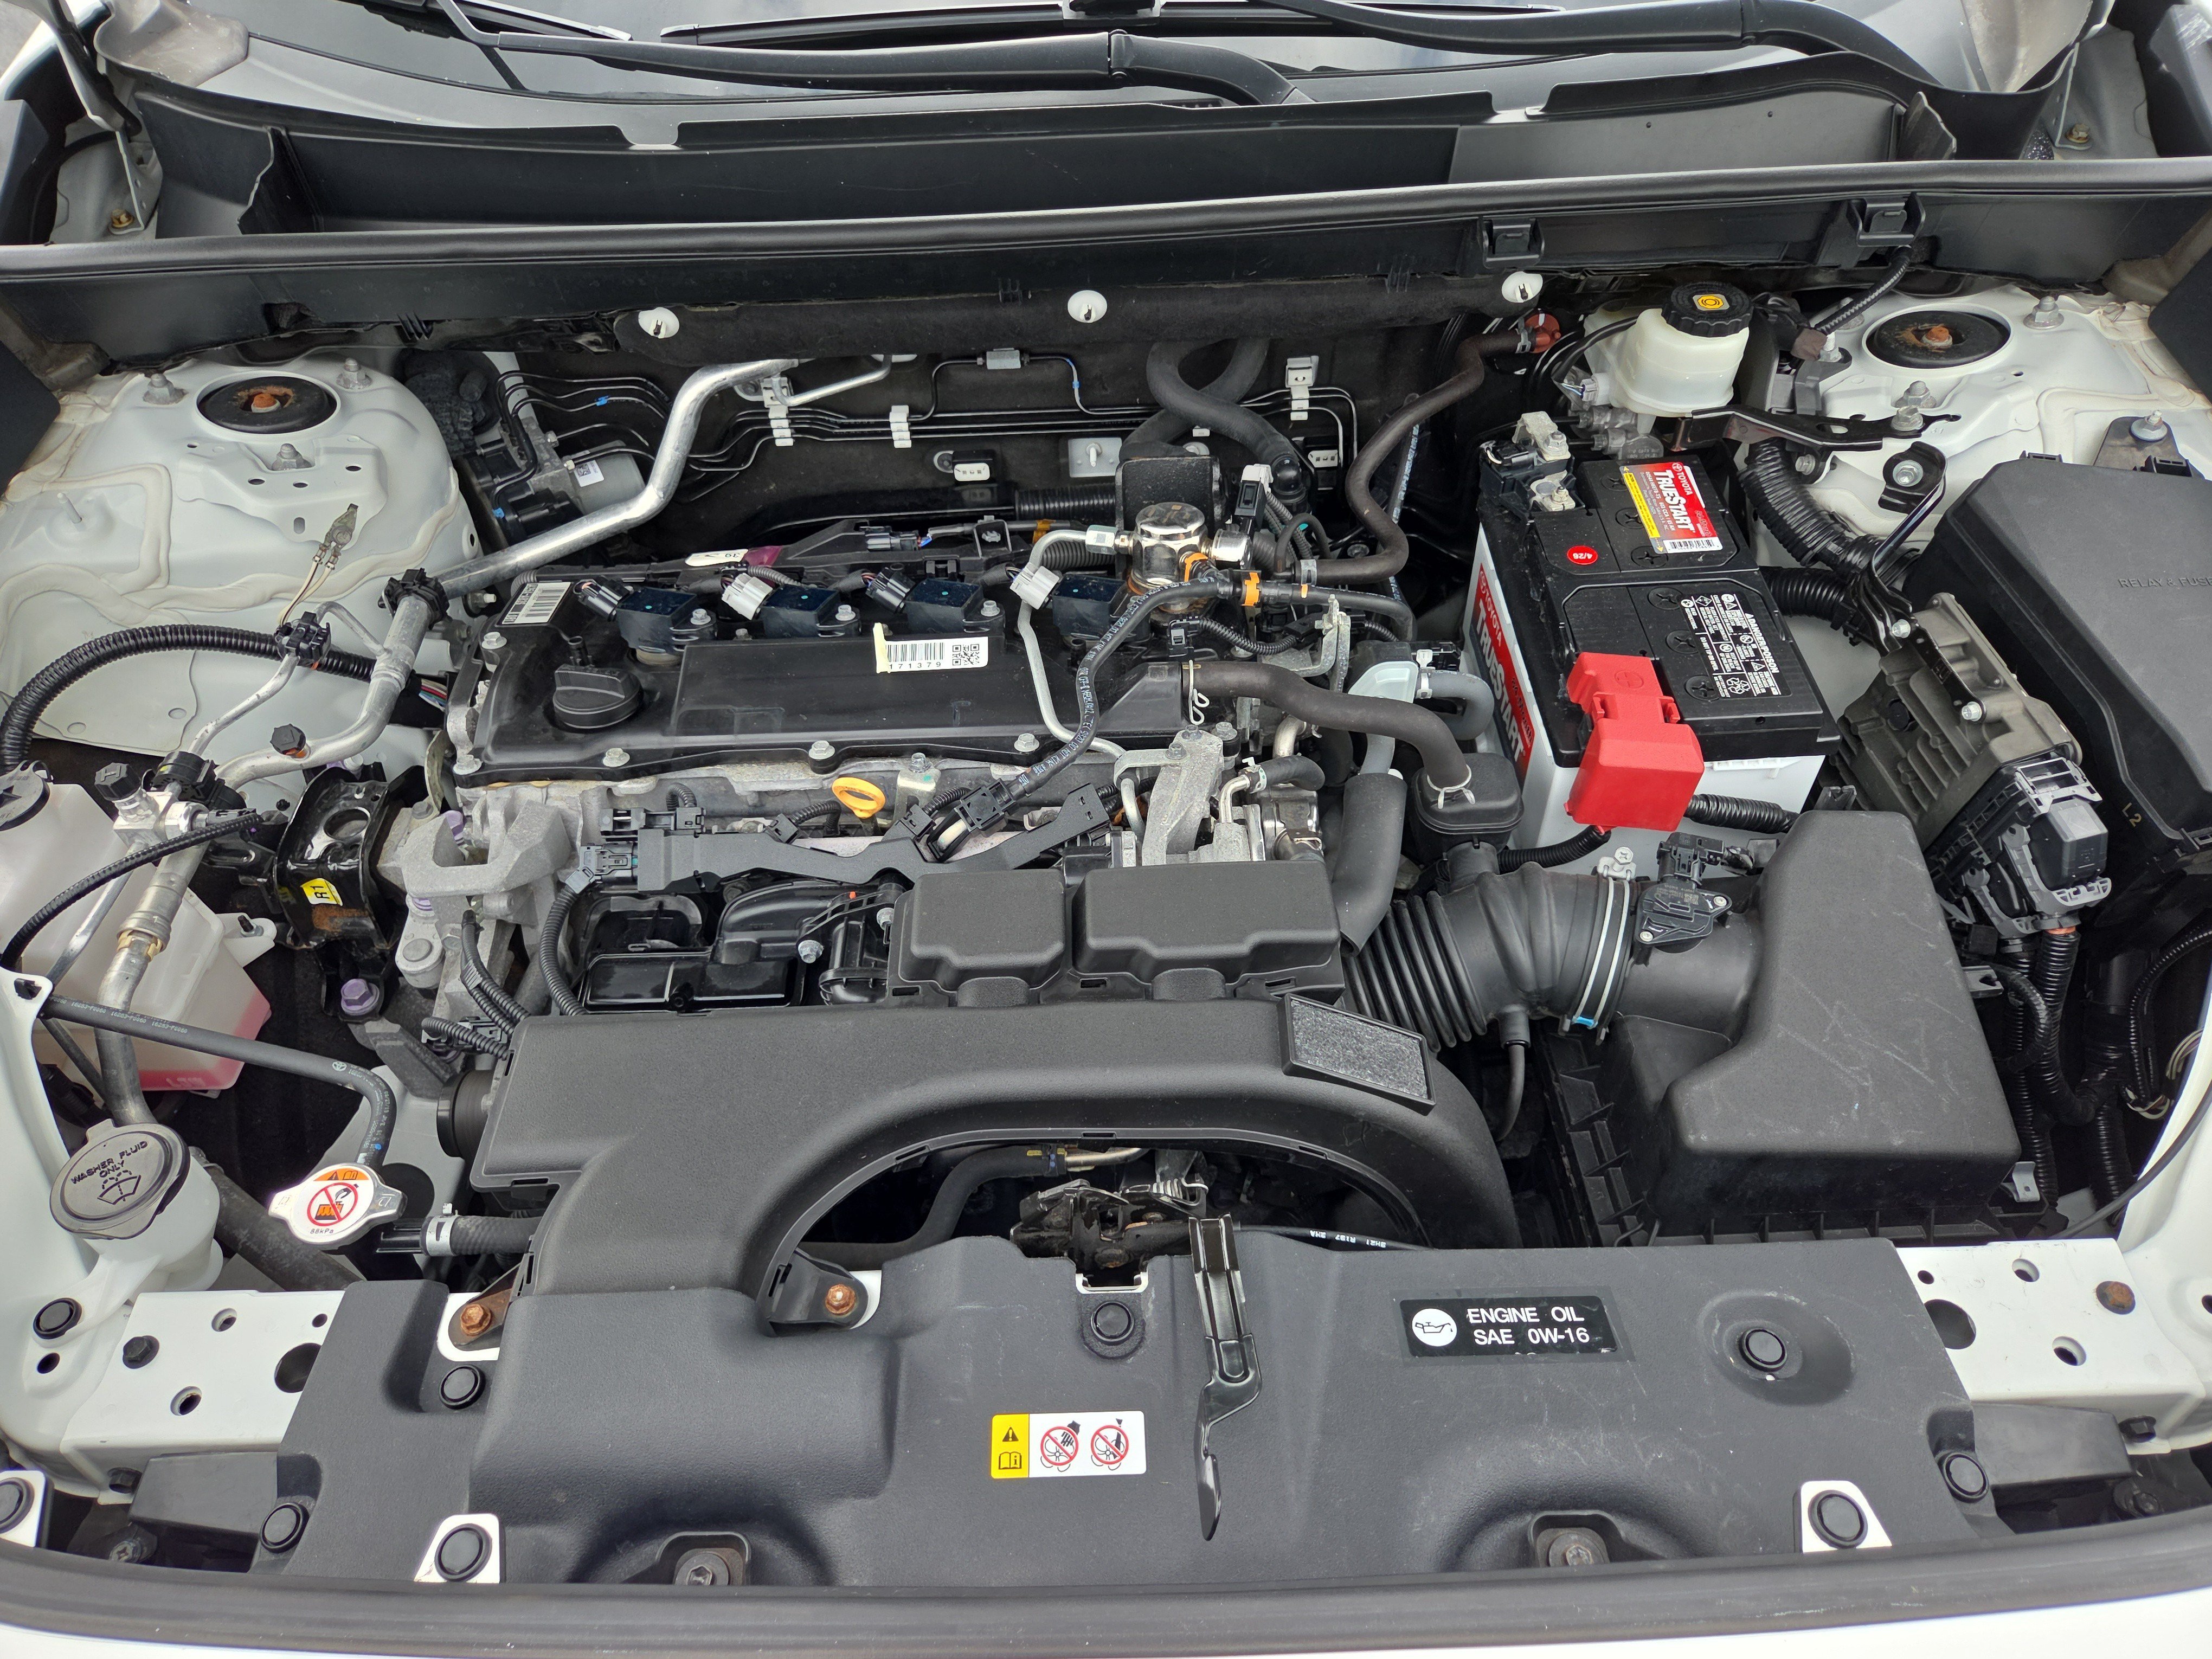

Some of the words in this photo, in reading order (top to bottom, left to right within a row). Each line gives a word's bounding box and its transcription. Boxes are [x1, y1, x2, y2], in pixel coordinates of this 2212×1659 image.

[1676, 472, 1693, 496] TOYOTA
[2118, 578, 2162, 587] RELAY
[2166, 578, 2176, 587] &
[1485, 592, 1502, 647] TOYOTA
[889, 660, 942, 670] 171379
[100, 765, 121, 782] H
[310, 886, 330, 899] R1
[71, 1158, 114, 1184] WASHER
[119, 1141, 148, 1159] FLUID
[99, 1159, 125, 1178] ONLY
[1467, 1307, 1540, 1323] ENGINE
[1551, 1306, 1585, 1322] OIL
[1474, 1328, 1515, 1345] SAE
[1528, 1327, 1590, 1345] 0W-16
